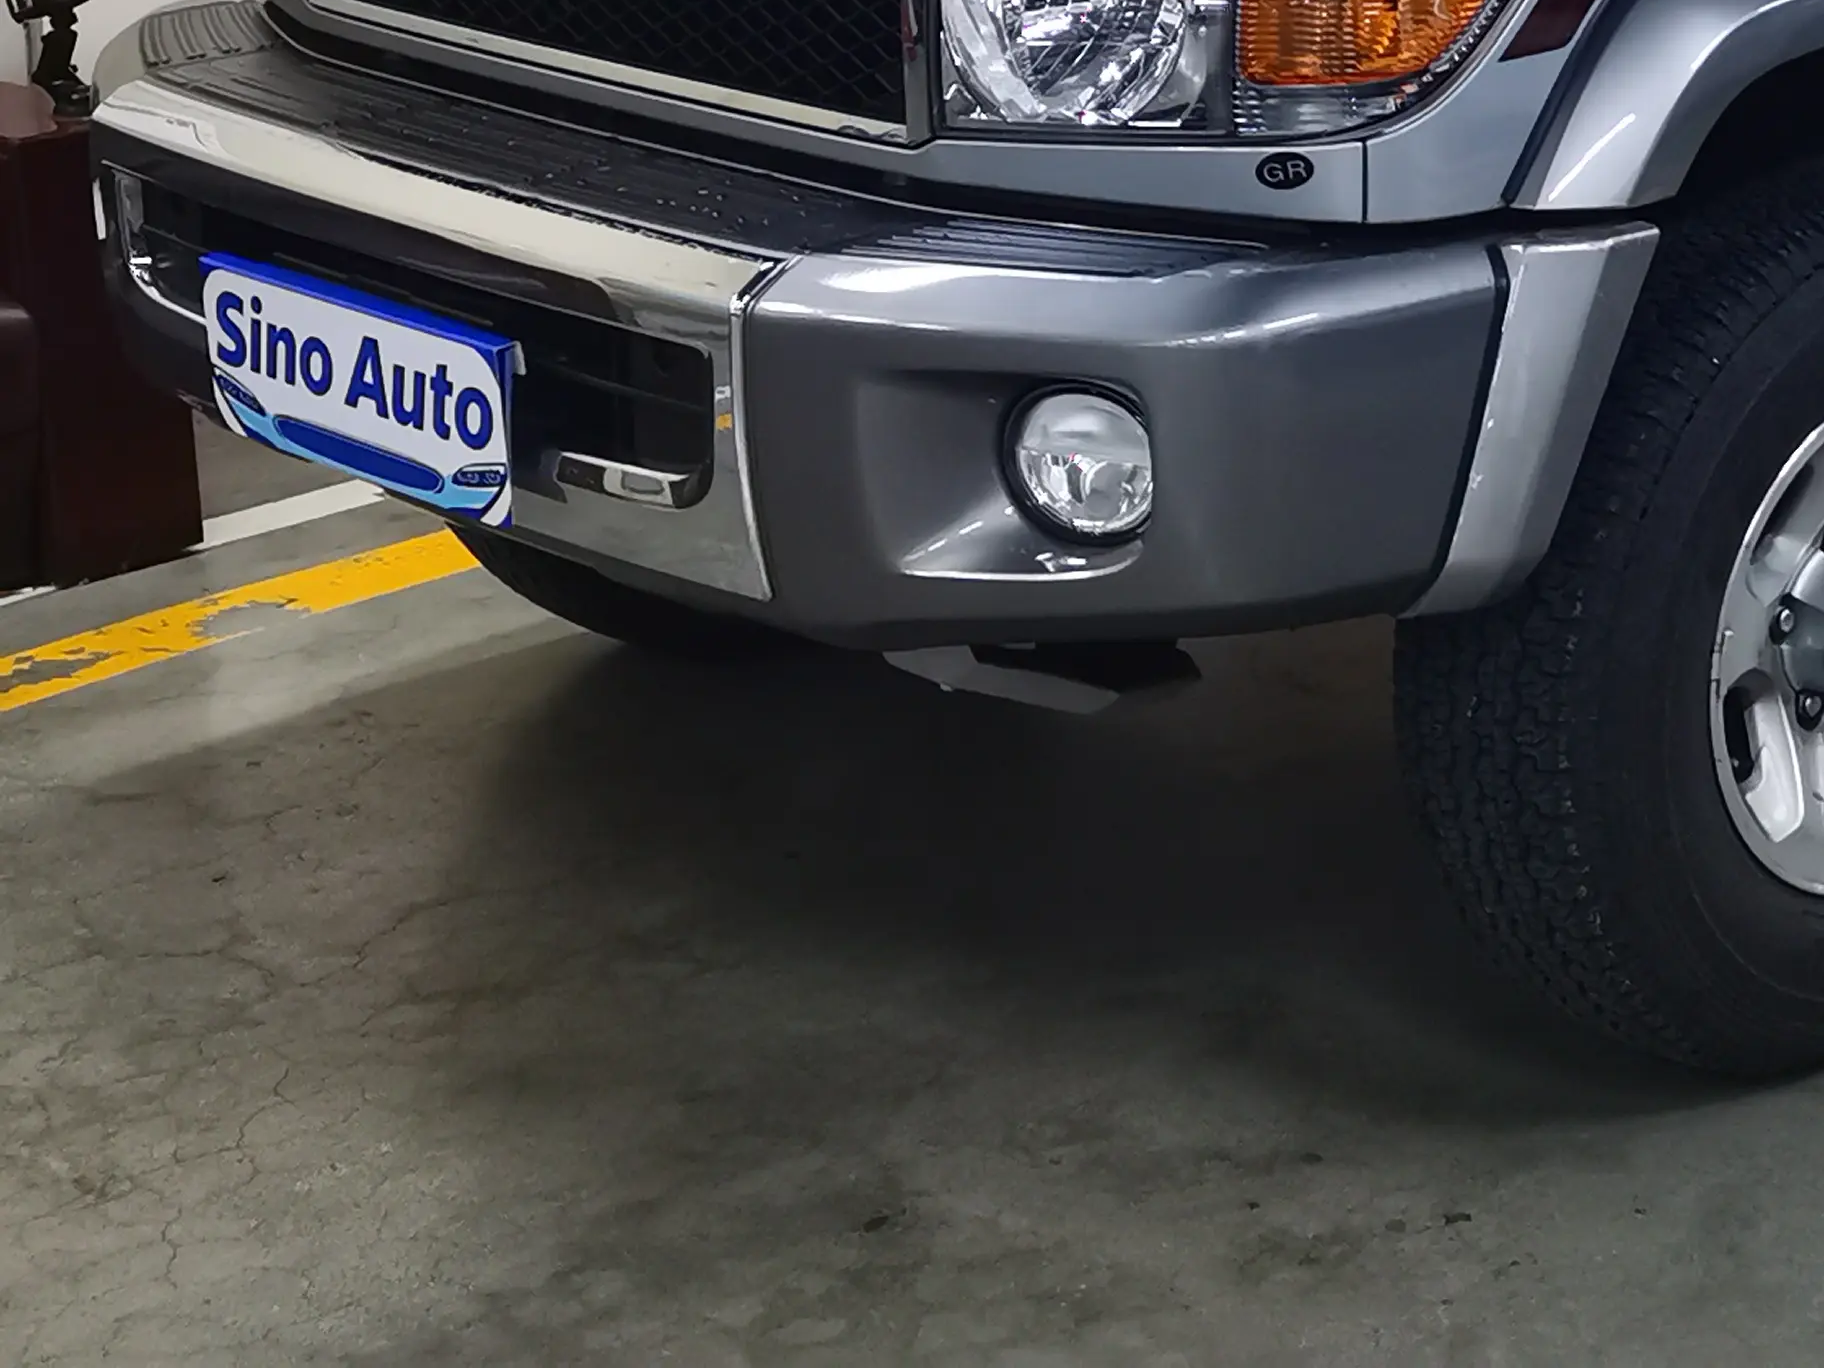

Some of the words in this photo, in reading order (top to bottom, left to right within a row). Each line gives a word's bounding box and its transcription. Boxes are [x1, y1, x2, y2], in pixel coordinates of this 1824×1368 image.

[1263, 159, 1308, 183] GR
[215, 290, 334, 397] Sino
[344, 336, 494, 451] Auto
